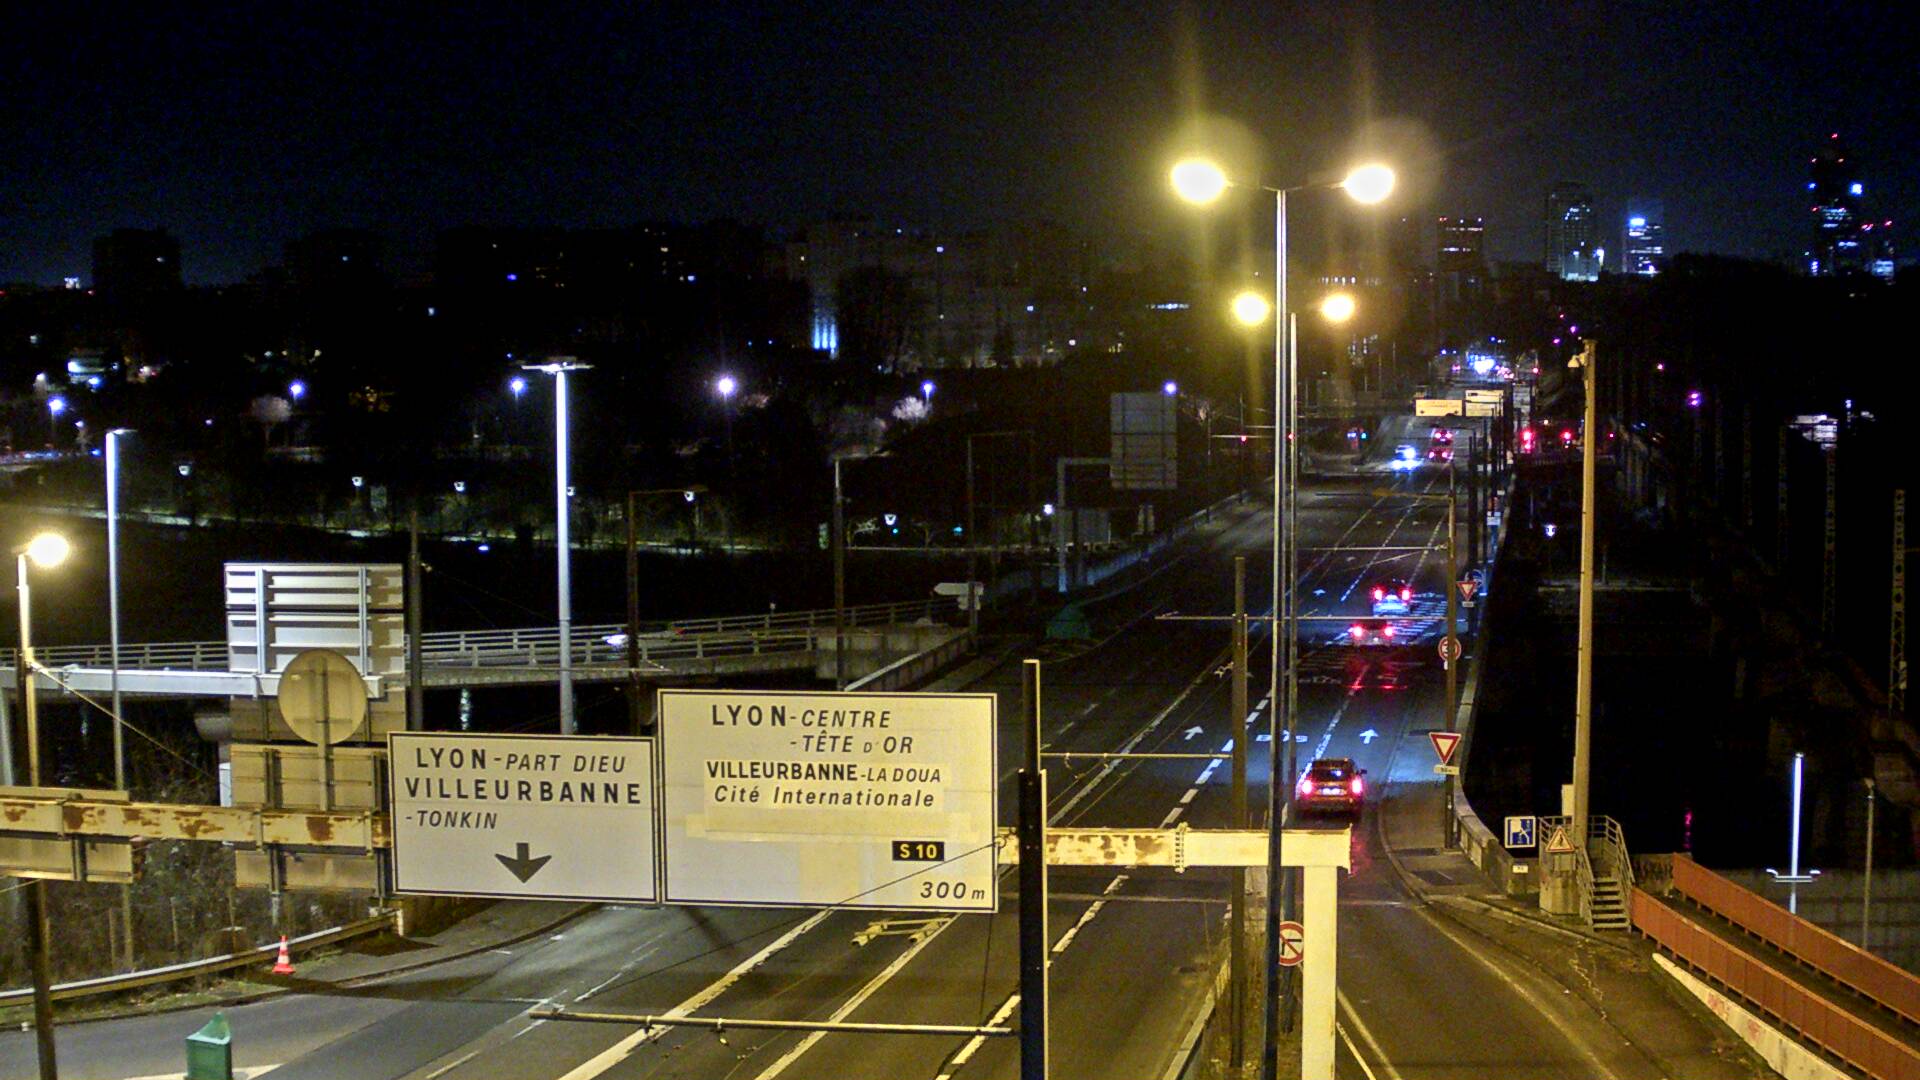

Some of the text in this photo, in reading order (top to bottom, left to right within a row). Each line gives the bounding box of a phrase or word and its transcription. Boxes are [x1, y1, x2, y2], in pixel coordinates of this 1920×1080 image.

[573, 755, 626, 773] DIEU
[892, 767, 941, 783] DOUA
[405, 777, 641, 804] VILLEURBANNE
[714, 785, 935, 807] Cité Internationale
[900, 843, 938, 859] S 10
[920, 881, 985, 900] 300 m
